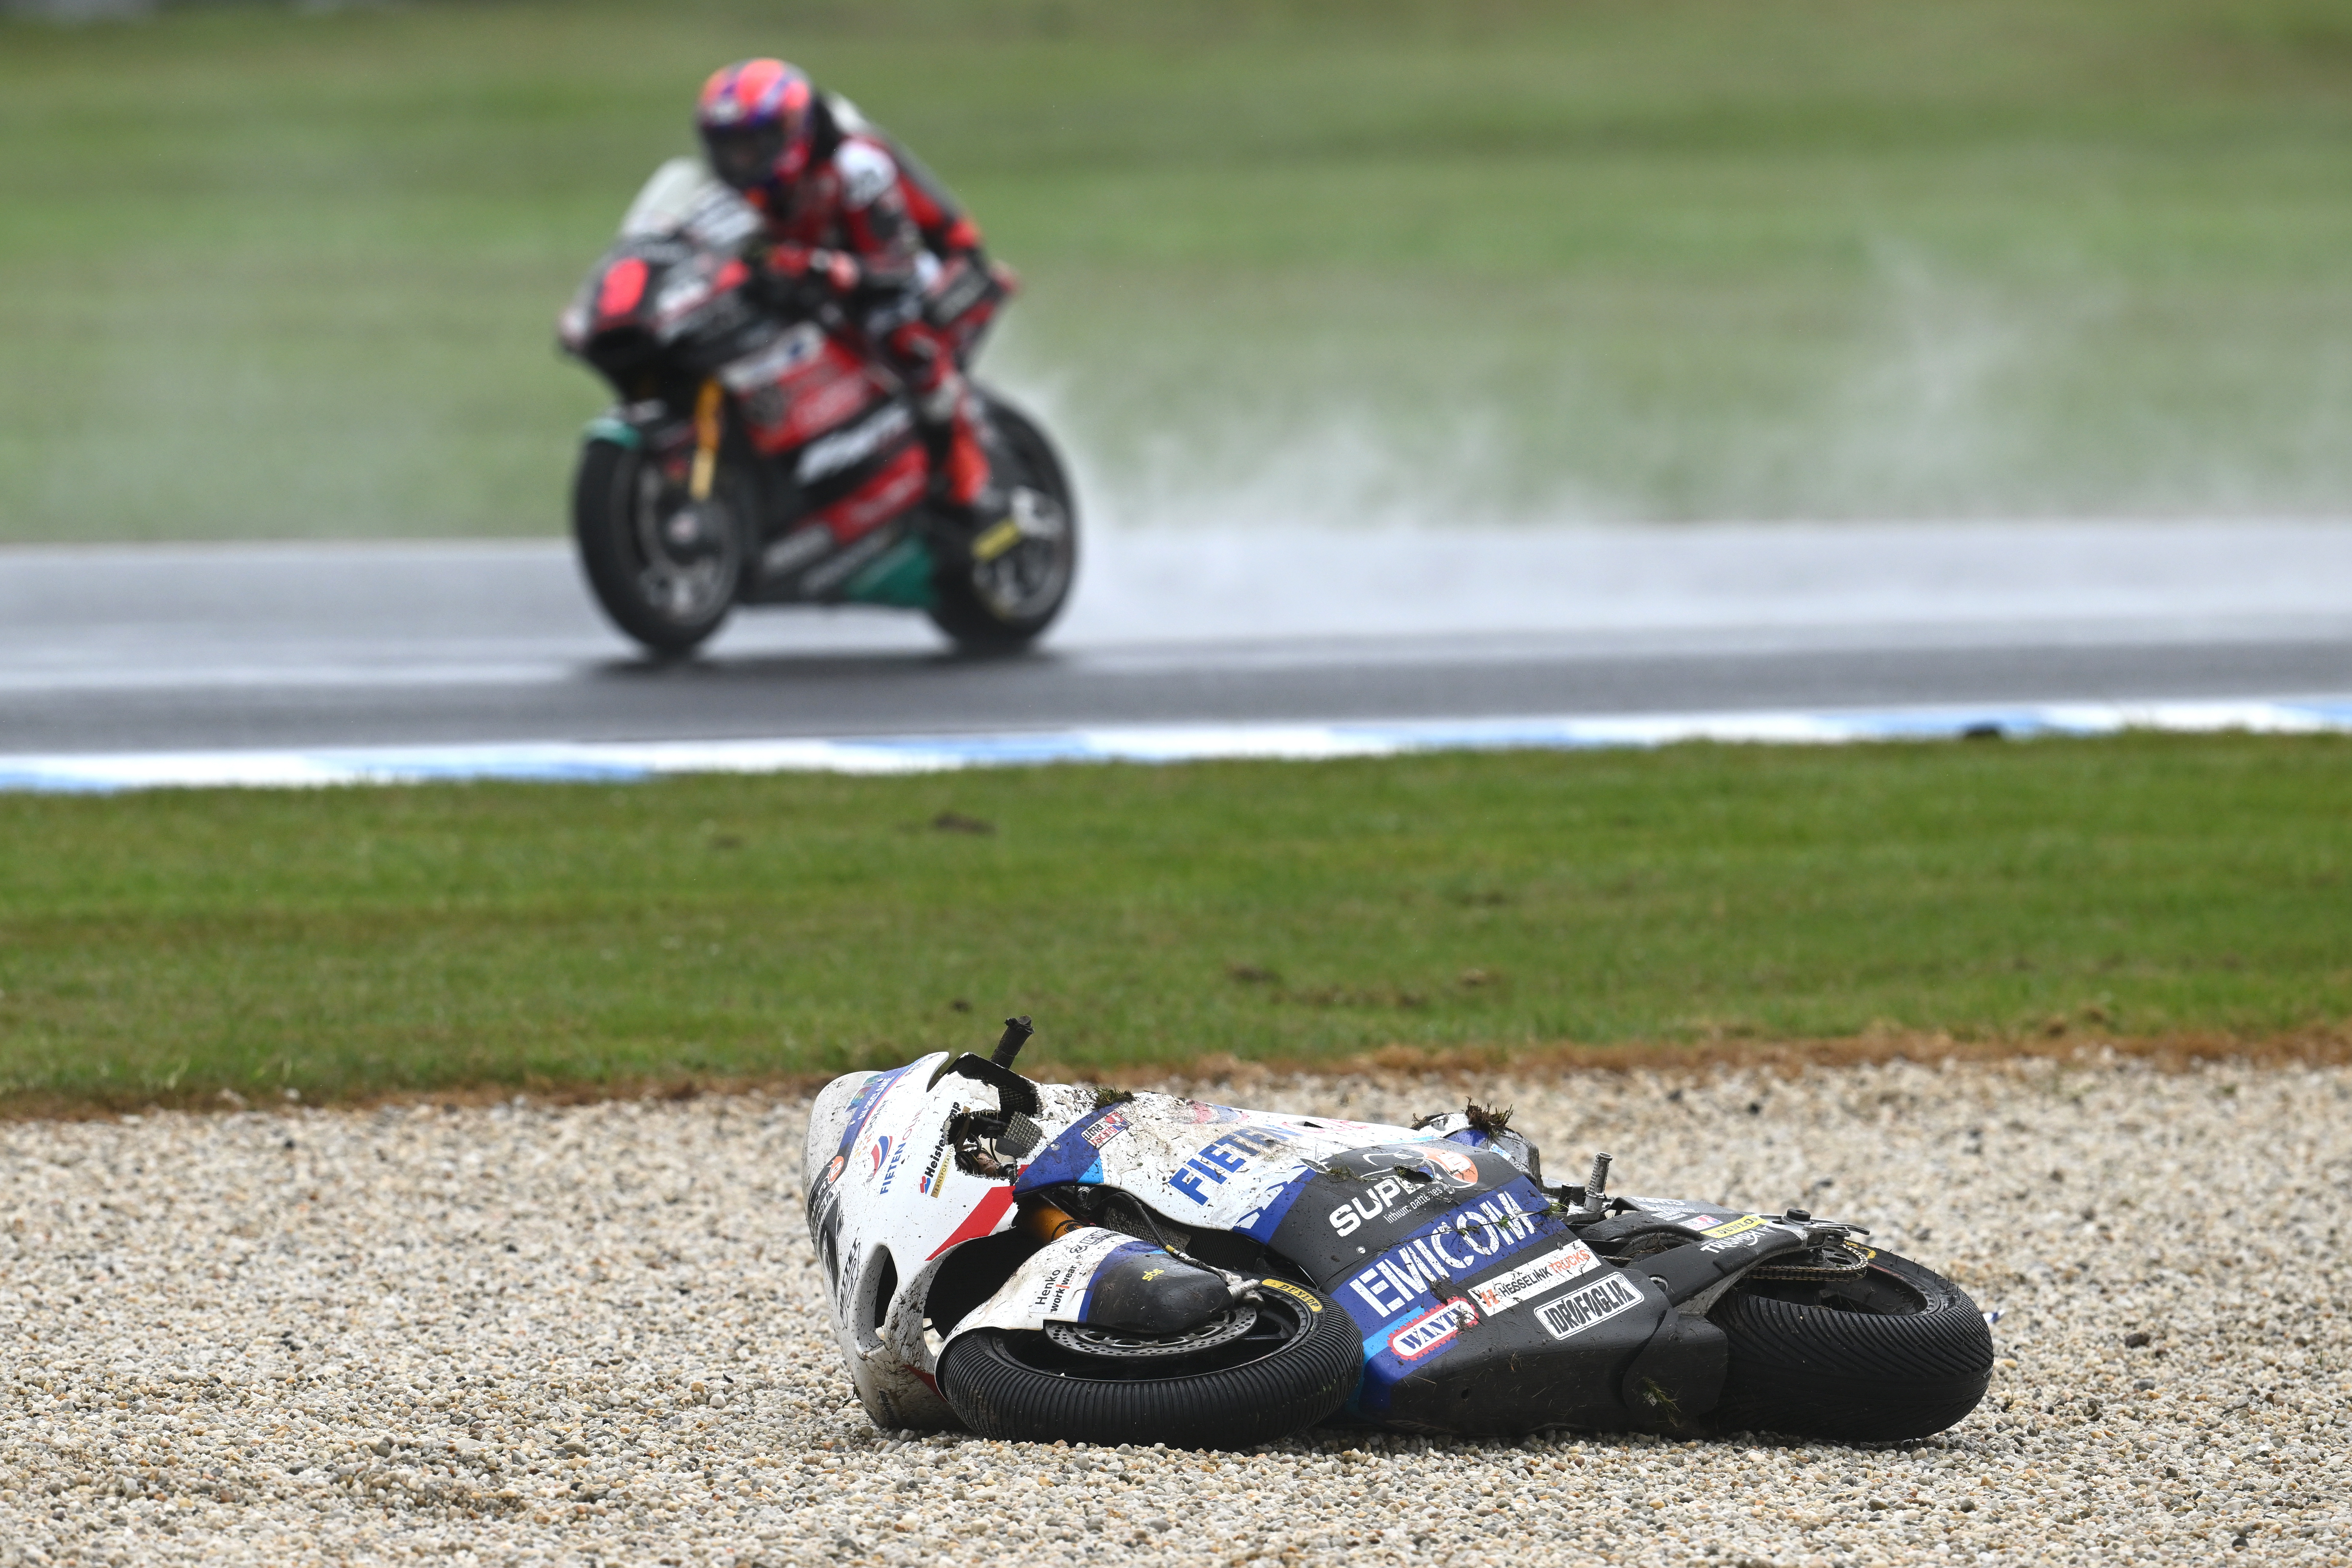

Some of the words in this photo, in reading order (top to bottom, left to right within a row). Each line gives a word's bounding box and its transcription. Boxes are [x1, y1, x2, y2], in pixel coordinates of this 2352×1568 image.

[1082, 1124, 1104, 1140] uma
[1091, 1126, 1117, 1145] racing
[880, 1142, 906, 1194] FIETEN
[903, 1108, 925, 1140] OLIE
[1383, 1205, 1411, 1224] lithium
[1715, 1217, 1759, 1234] DUNLOP
[1700, 1229, 1765, 1253] TRIUMPH
[1349, 1191, 1535, 1318] EMICOM
[840, 1238, 857, 1320] METTET
[1142, 1269, 1164, 1282] sbs
[1498, 1266, 1553, 1297] HESSELINK
[1549, 1250, 1591, 1274] TRUCKS
[1035, 1270, 1061, 1305] Henko
[1278, 1284, 1321, 1307] DUNLOP
